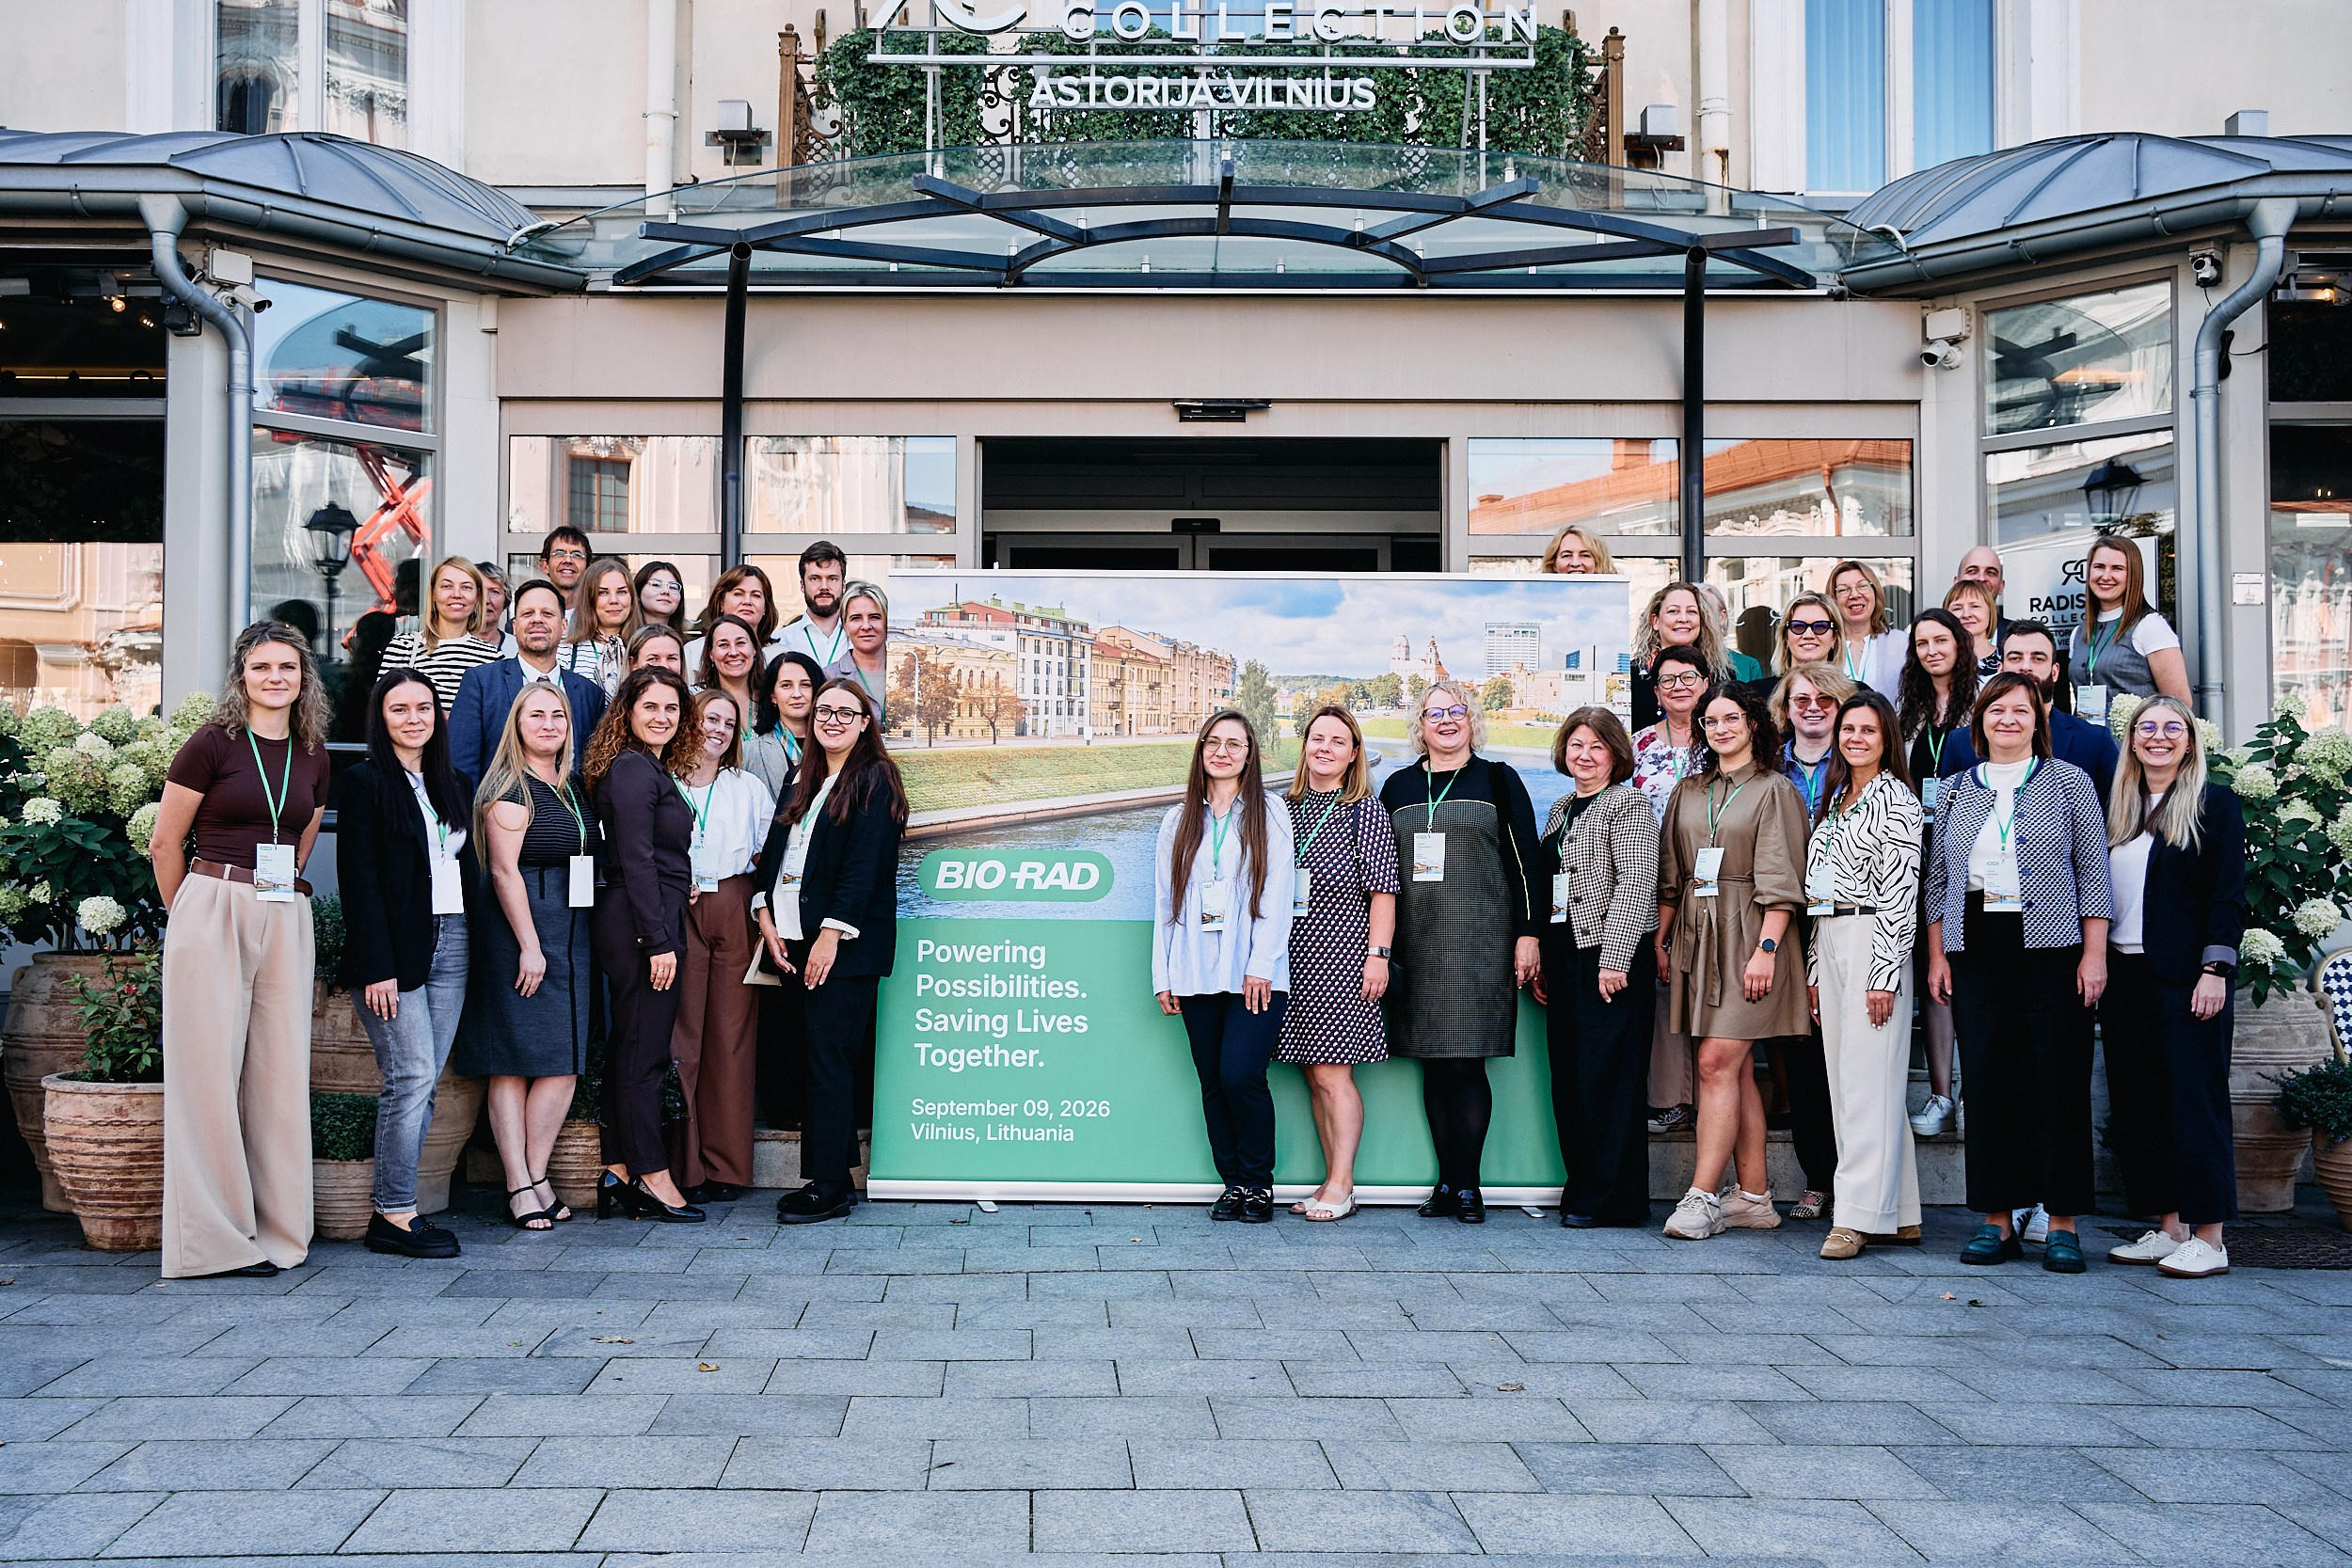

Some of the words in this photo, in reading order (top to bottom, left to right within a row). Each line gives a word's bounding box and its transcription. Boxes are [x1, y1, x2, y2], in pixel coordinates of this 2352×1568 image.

[1061, 1, 1538, 46] COLLECTION
[1028, 74, 1216, 109] ASTORIJA
[1225, 76, 1376, 110] VILNIUS
[2029, 593, 2086, 612] RADIS
[917, 939, 1046, 970] Powering
[916, 974, 1088, 999] Possibilities.
[914, 1008, 1009, 1038] Saving
[1017, 1008, 1089, 1034] Lives
[914, 1043, 1045, 1073] Together.
[911, 1098, 1018, 1120] September
[1023, 1100, 1054, 1121] 09,
[1060, 1100, 1111, 1117] 2026
[911, 1122, 980, 1145] Vilnius,
[987, 1123, 1074, 1142] Lithuania
